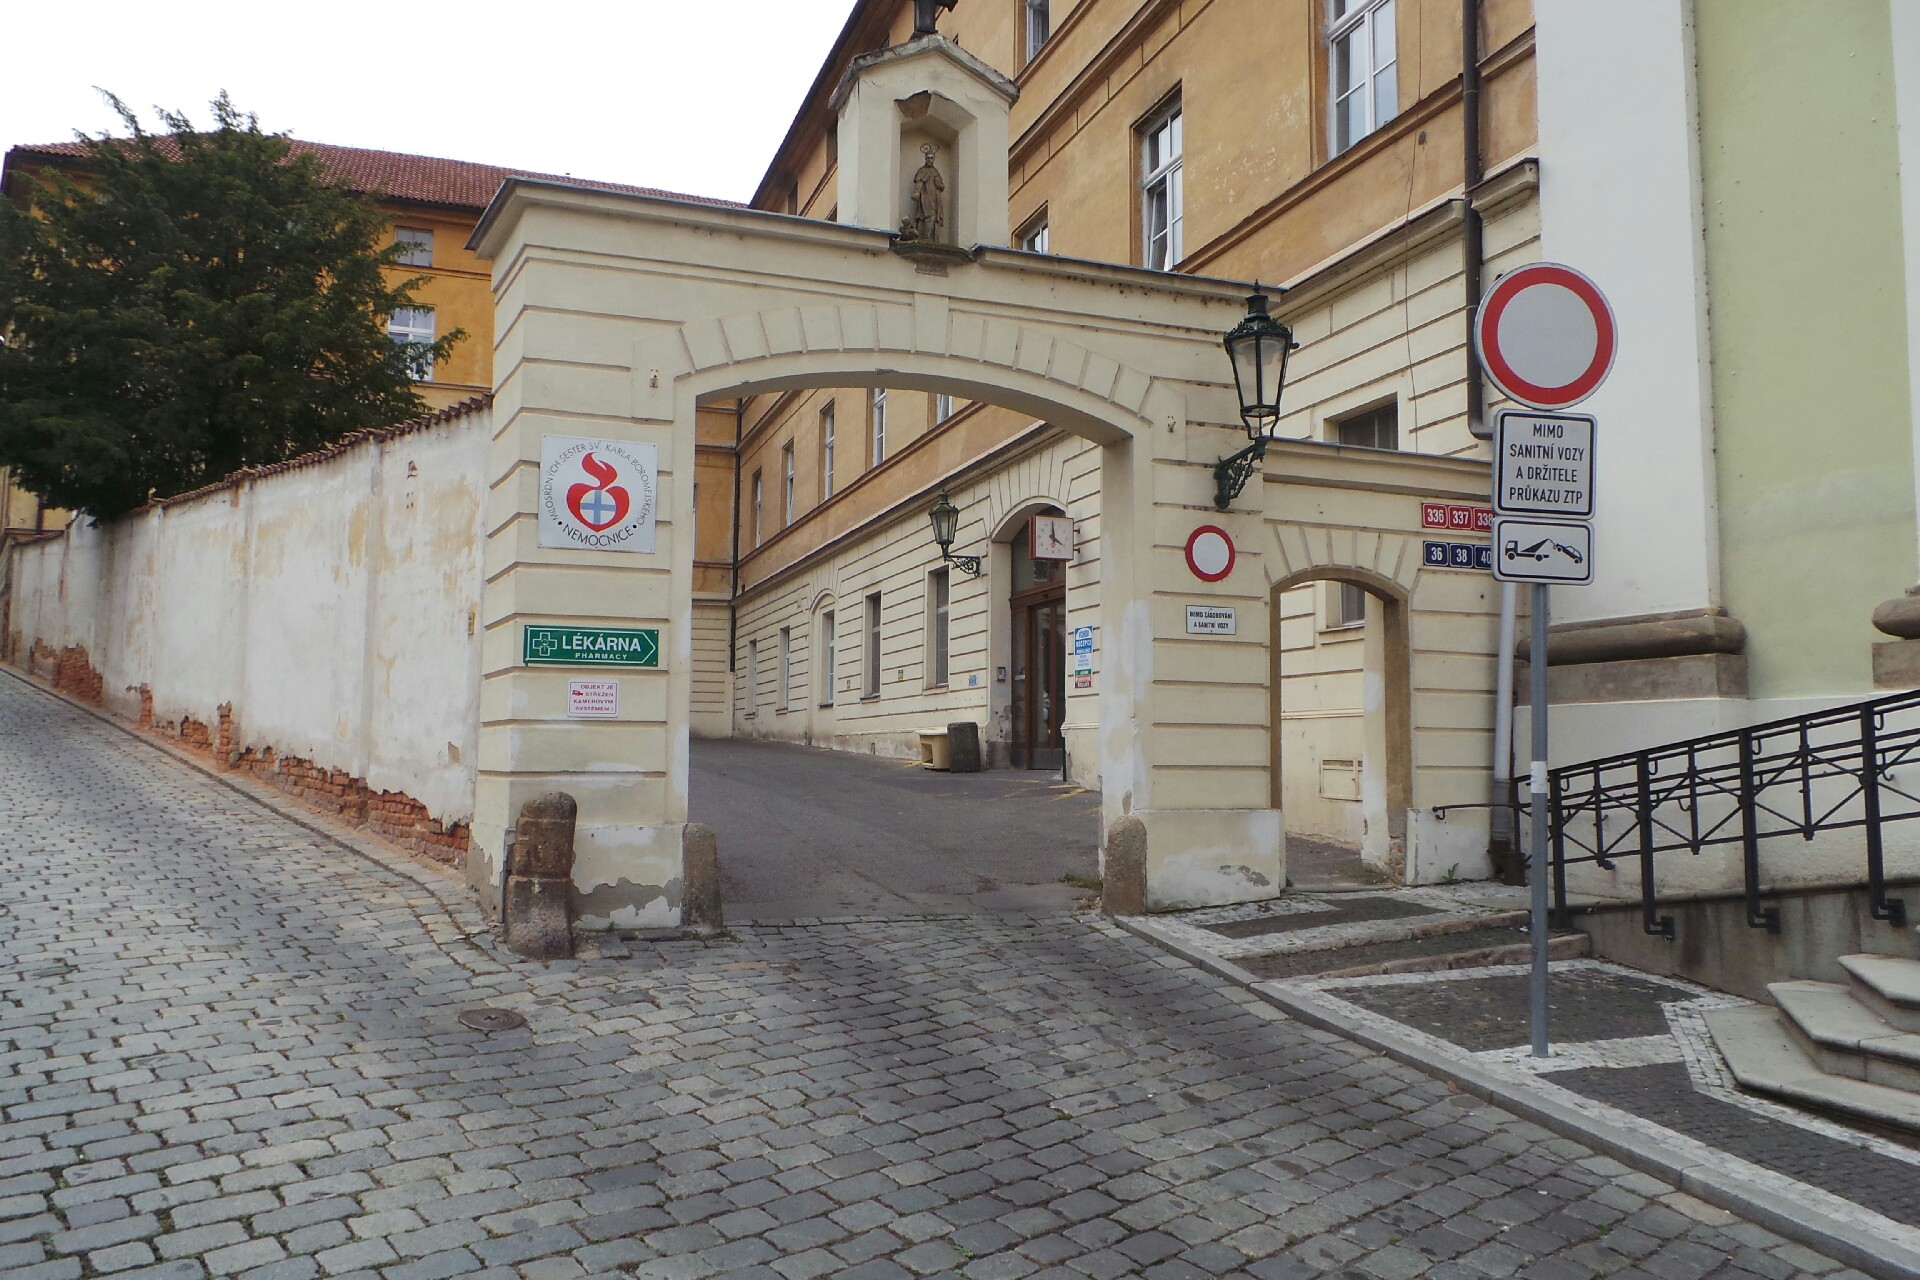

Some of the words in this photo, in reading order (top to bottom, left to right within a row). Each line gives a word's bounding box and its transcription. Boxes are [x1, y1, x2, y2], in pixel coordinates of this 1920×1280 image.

[1532, 423, 1564, 438] MIMO
[559, 443, 587, 463] SESTER
[605, 444, 631, 461] KARLA
[1509, 443, 1555, 459] SANITNÍ
[1557, 446, 1585, 461] VOZY
[1515, 465, 1524, 480] A
[1527, 464, 1578, 482] DRŽITELE
[1509, 484, 1560, 503] PRŮKAZU
[1563, 490, 1583, 505] ZTP
[1427, 508, 1445, 523] 336
[1452, 510, 1469, 525] 337
[1477, 512, 1493, 526] 338
[562, 524, 634, 547] NEMOCNICE
[1431, 546, 1443, 561] 36
[1456, 548, 1468, 563] 38
[1480, 550, 1492, 564] 40
[562, 633, 641, 652] LÉKÁRNA
[575, 652, 628, 660] PHARMACY
